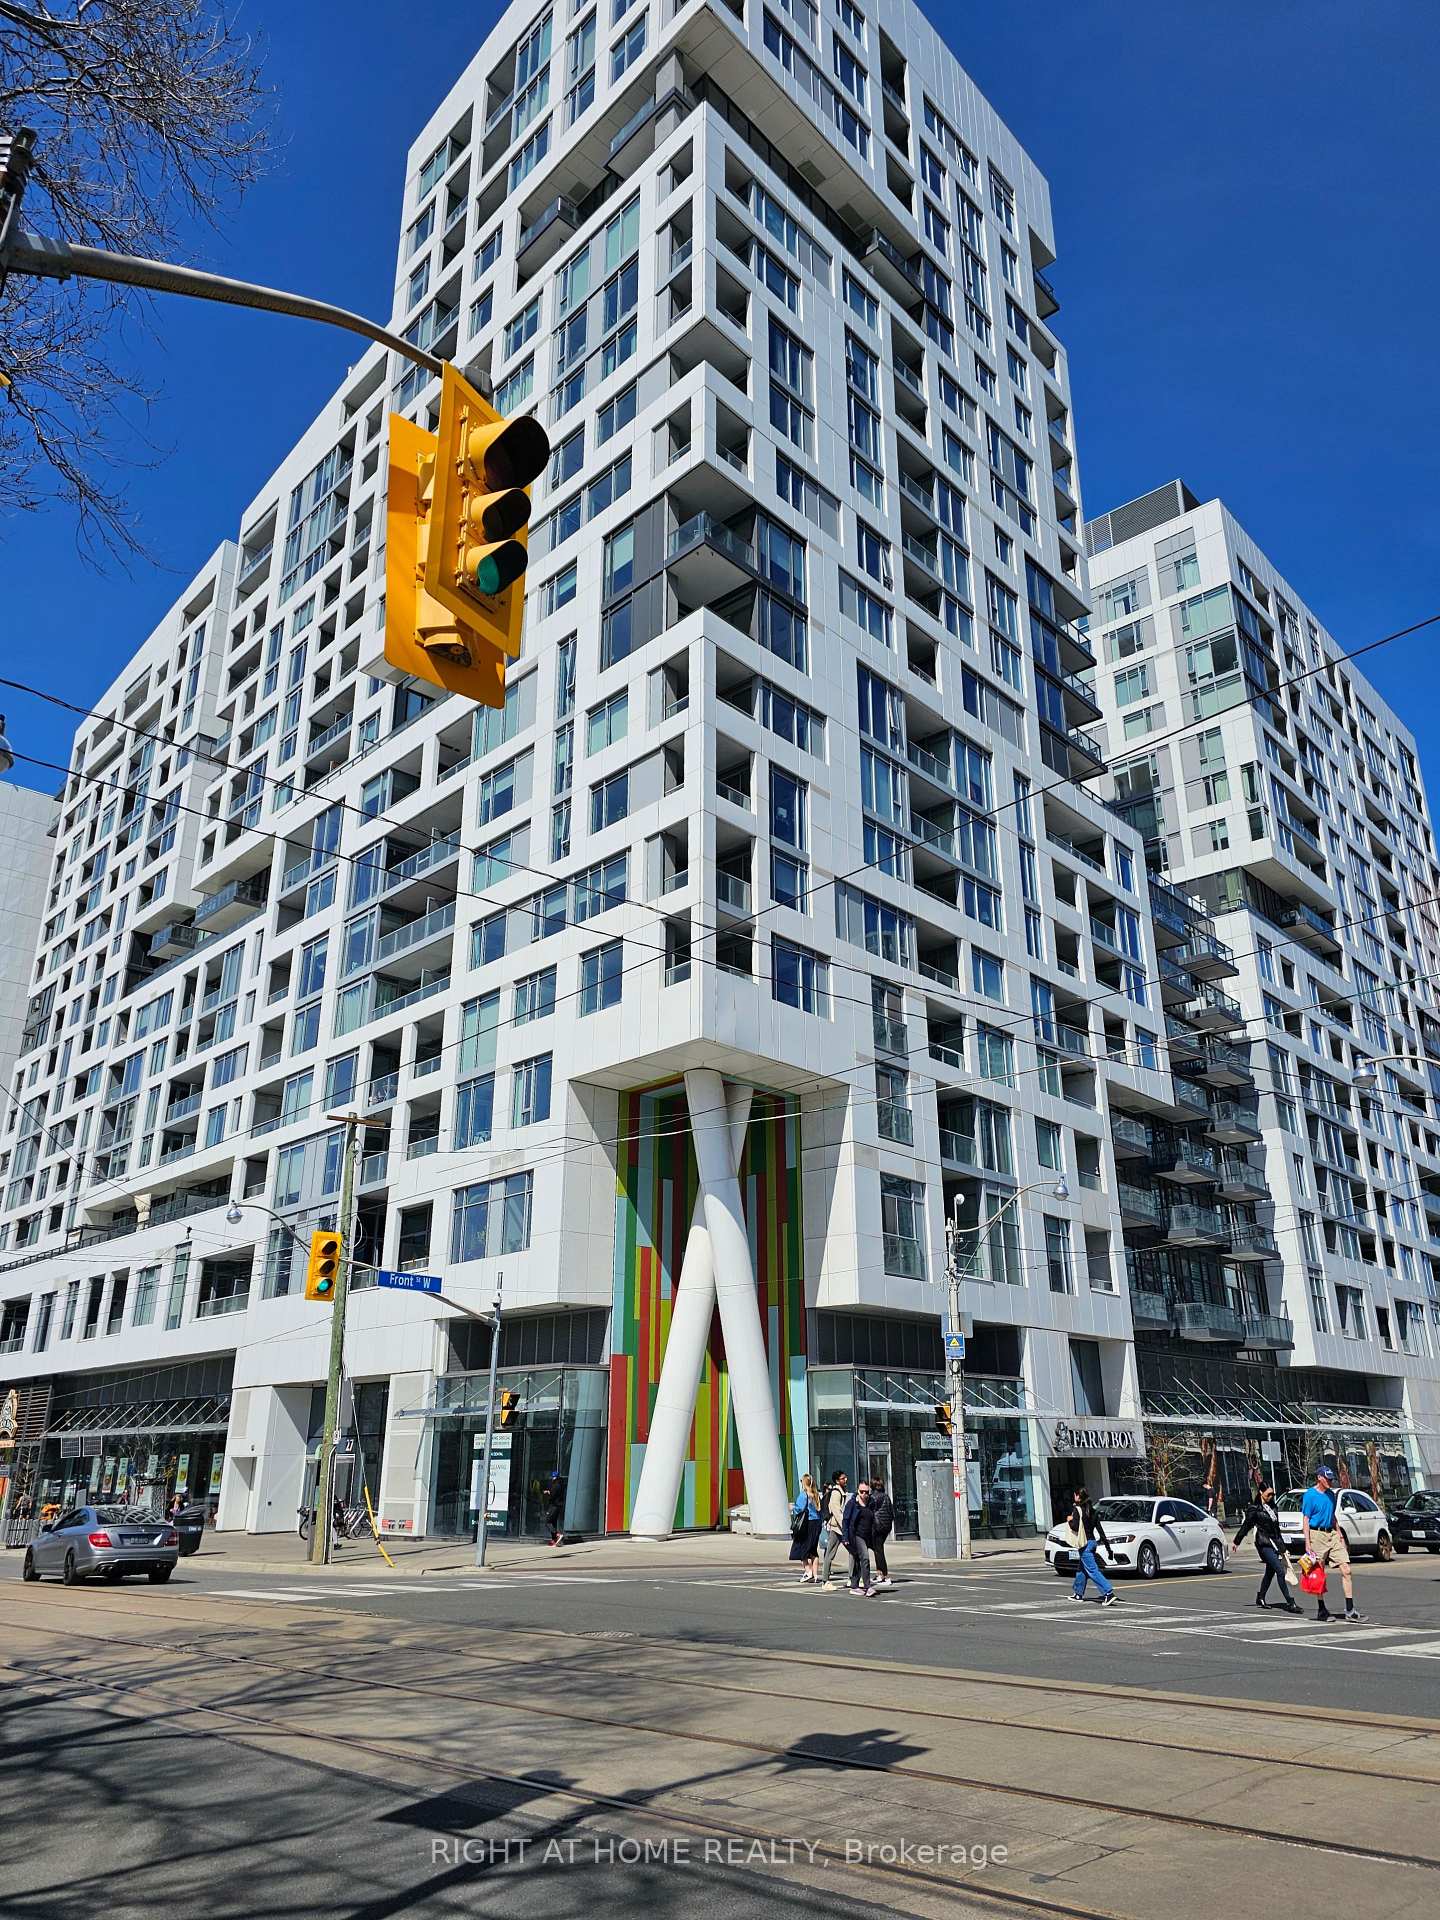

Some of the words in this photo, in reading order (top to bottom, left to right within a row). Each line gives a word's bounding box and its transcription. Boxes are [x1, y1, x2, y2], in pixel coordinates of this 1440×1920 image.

[390, 1273, 414, 1287] Front
[423, 1277, 431, 1289] W
[1073, 1430, 1109, 1448] FARM
[1110, 1431, 1135, 1448] BOY
